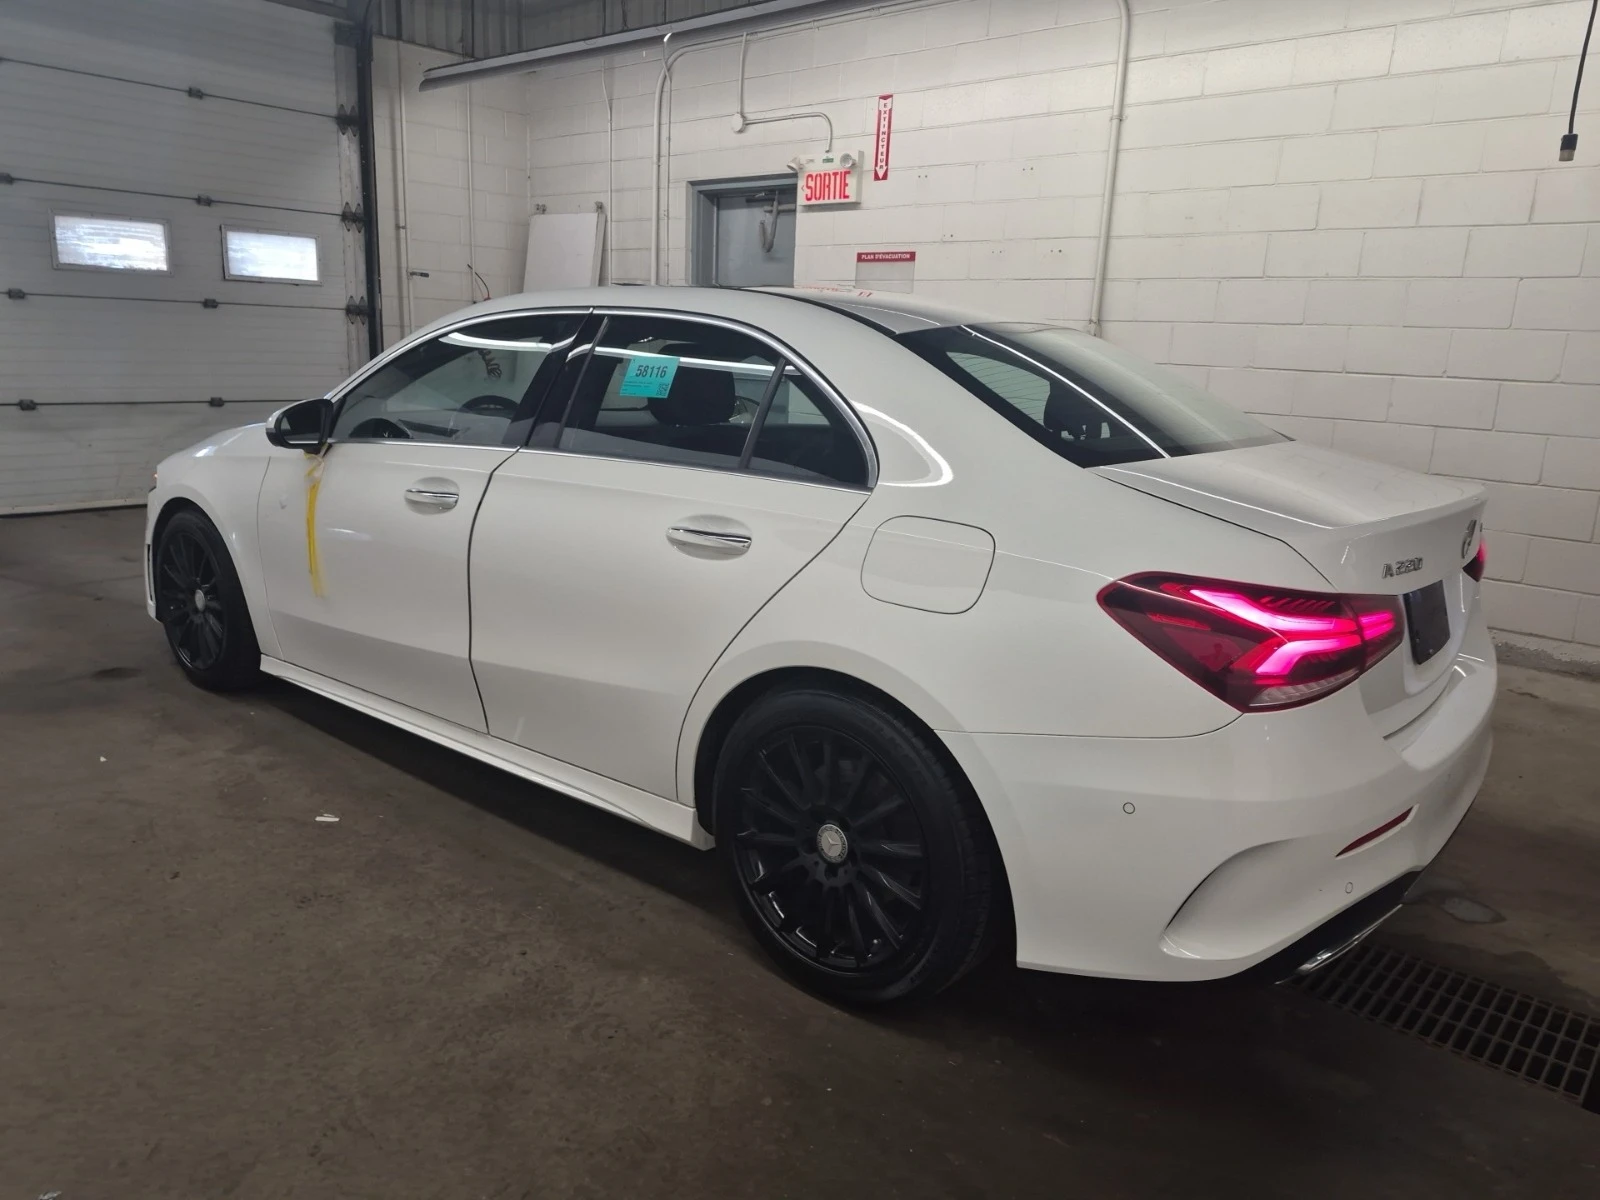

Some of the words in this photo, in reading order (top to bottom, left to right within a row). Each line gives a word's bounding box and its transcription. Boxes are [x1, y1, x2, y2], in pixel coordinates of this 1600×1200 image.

[879, 102, 888, 170] EXTINCTEUR
[805, 170, 851, 202] SORTIE
[635, 364, 668, 379] 58116
